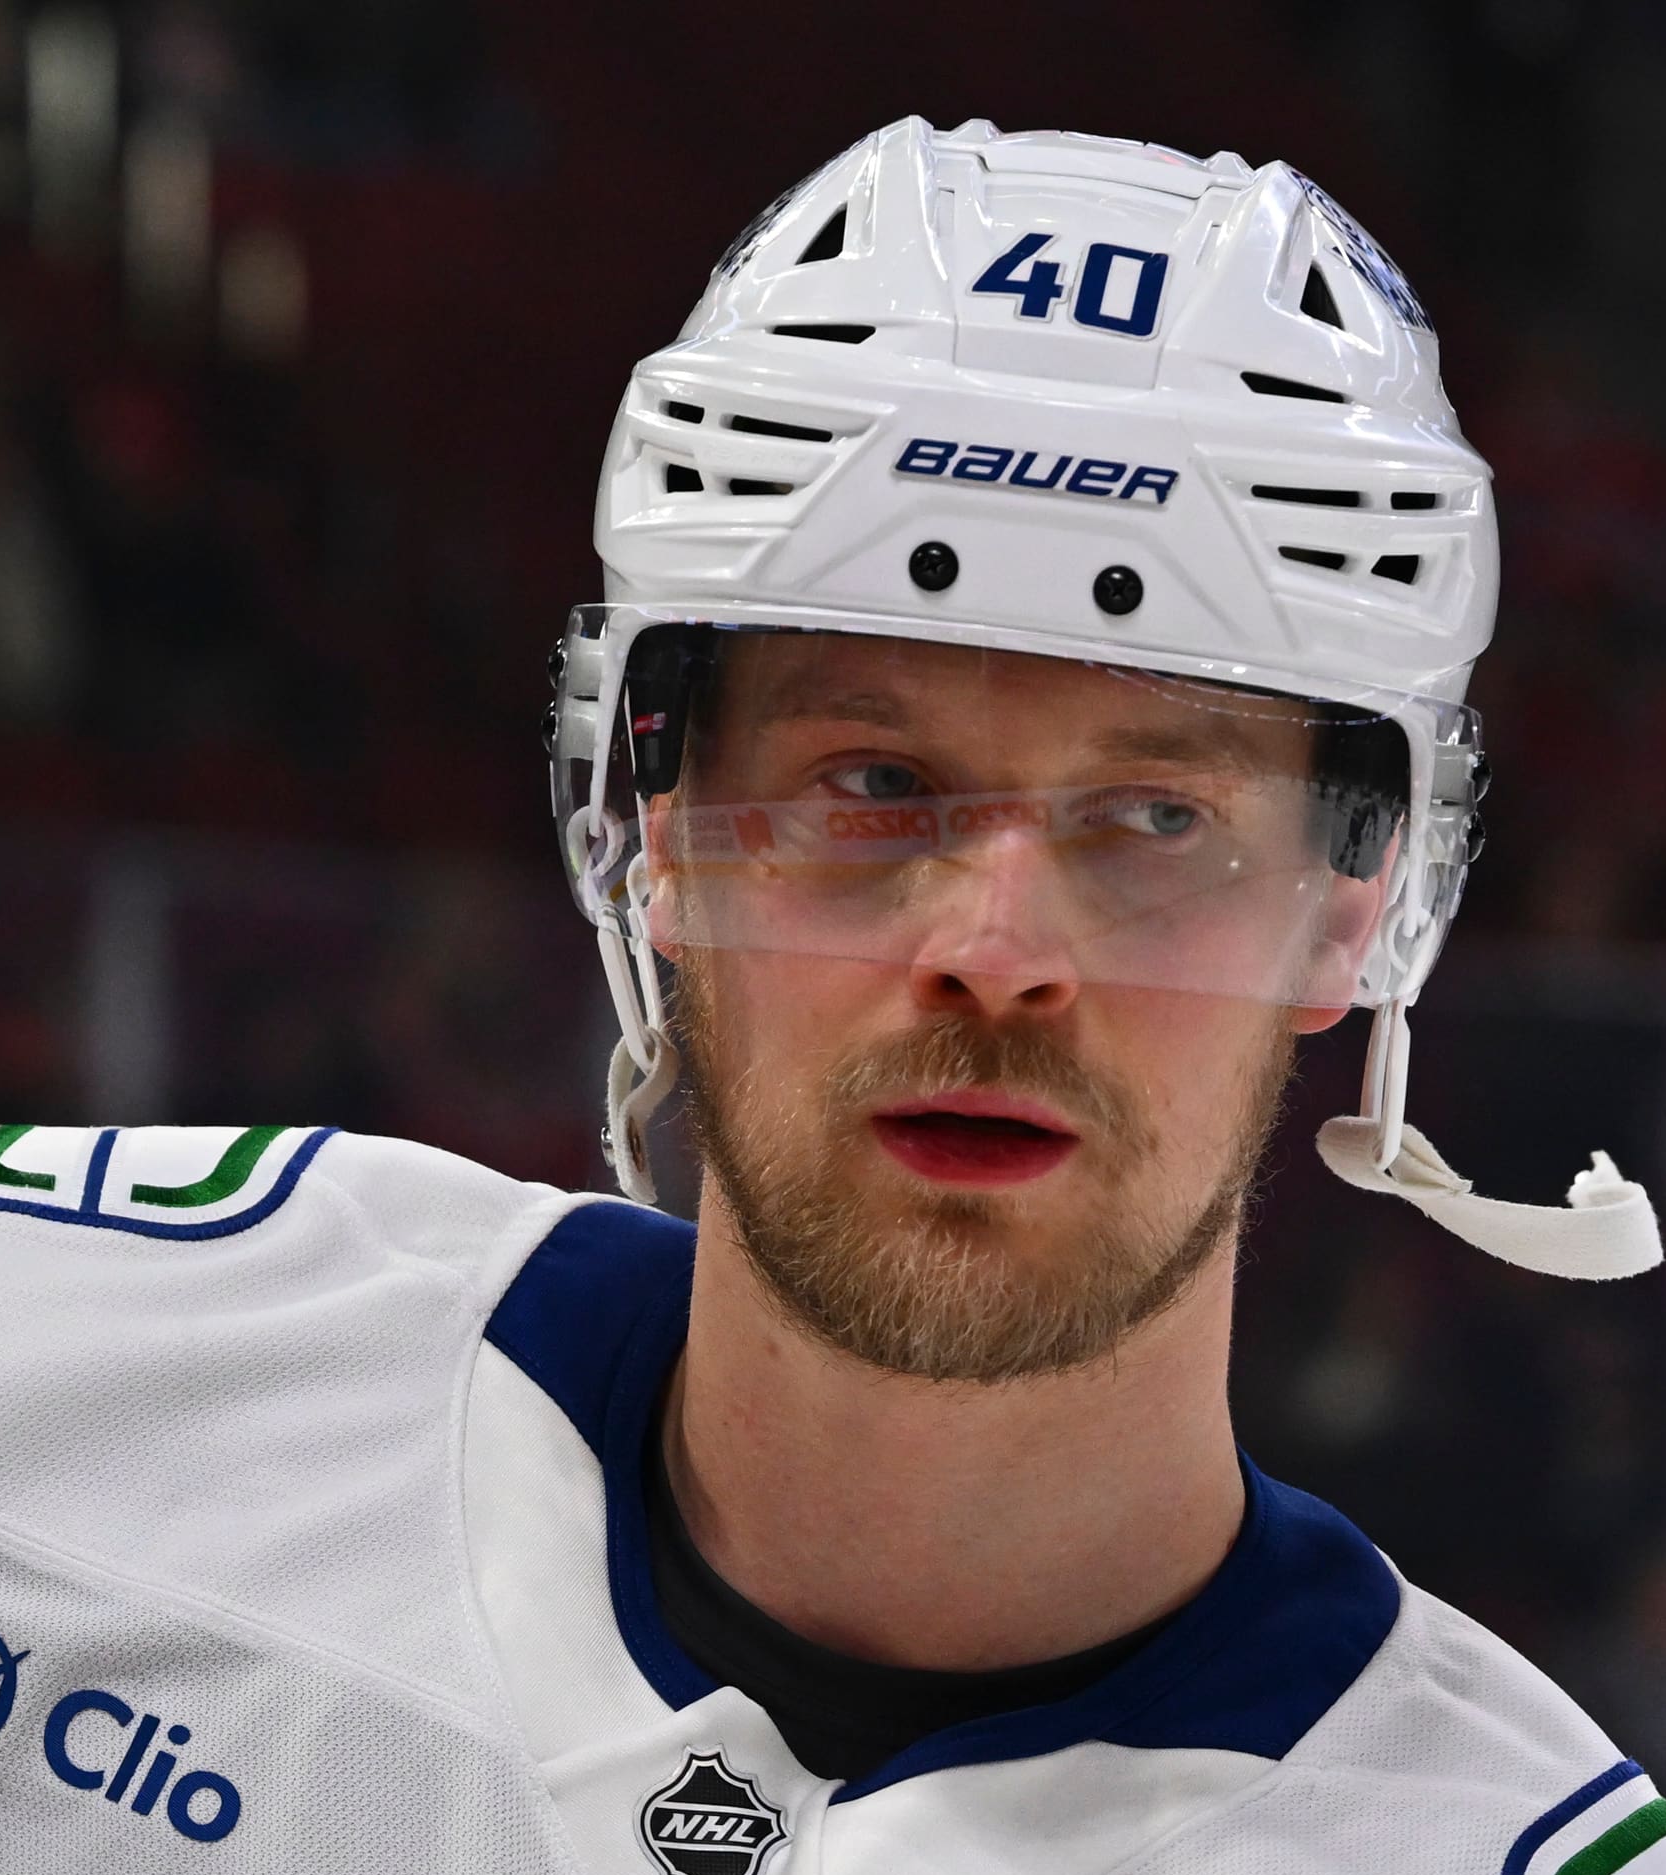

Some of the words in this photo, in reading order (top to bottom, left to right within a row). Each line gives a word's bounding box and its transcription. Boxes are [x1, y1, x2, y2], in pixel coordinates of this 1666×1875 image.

[971, 232, 1170, 337] 40
[43, 1688, 241, 1842] Clio
[657, 1812, 757, 1844] NHL
